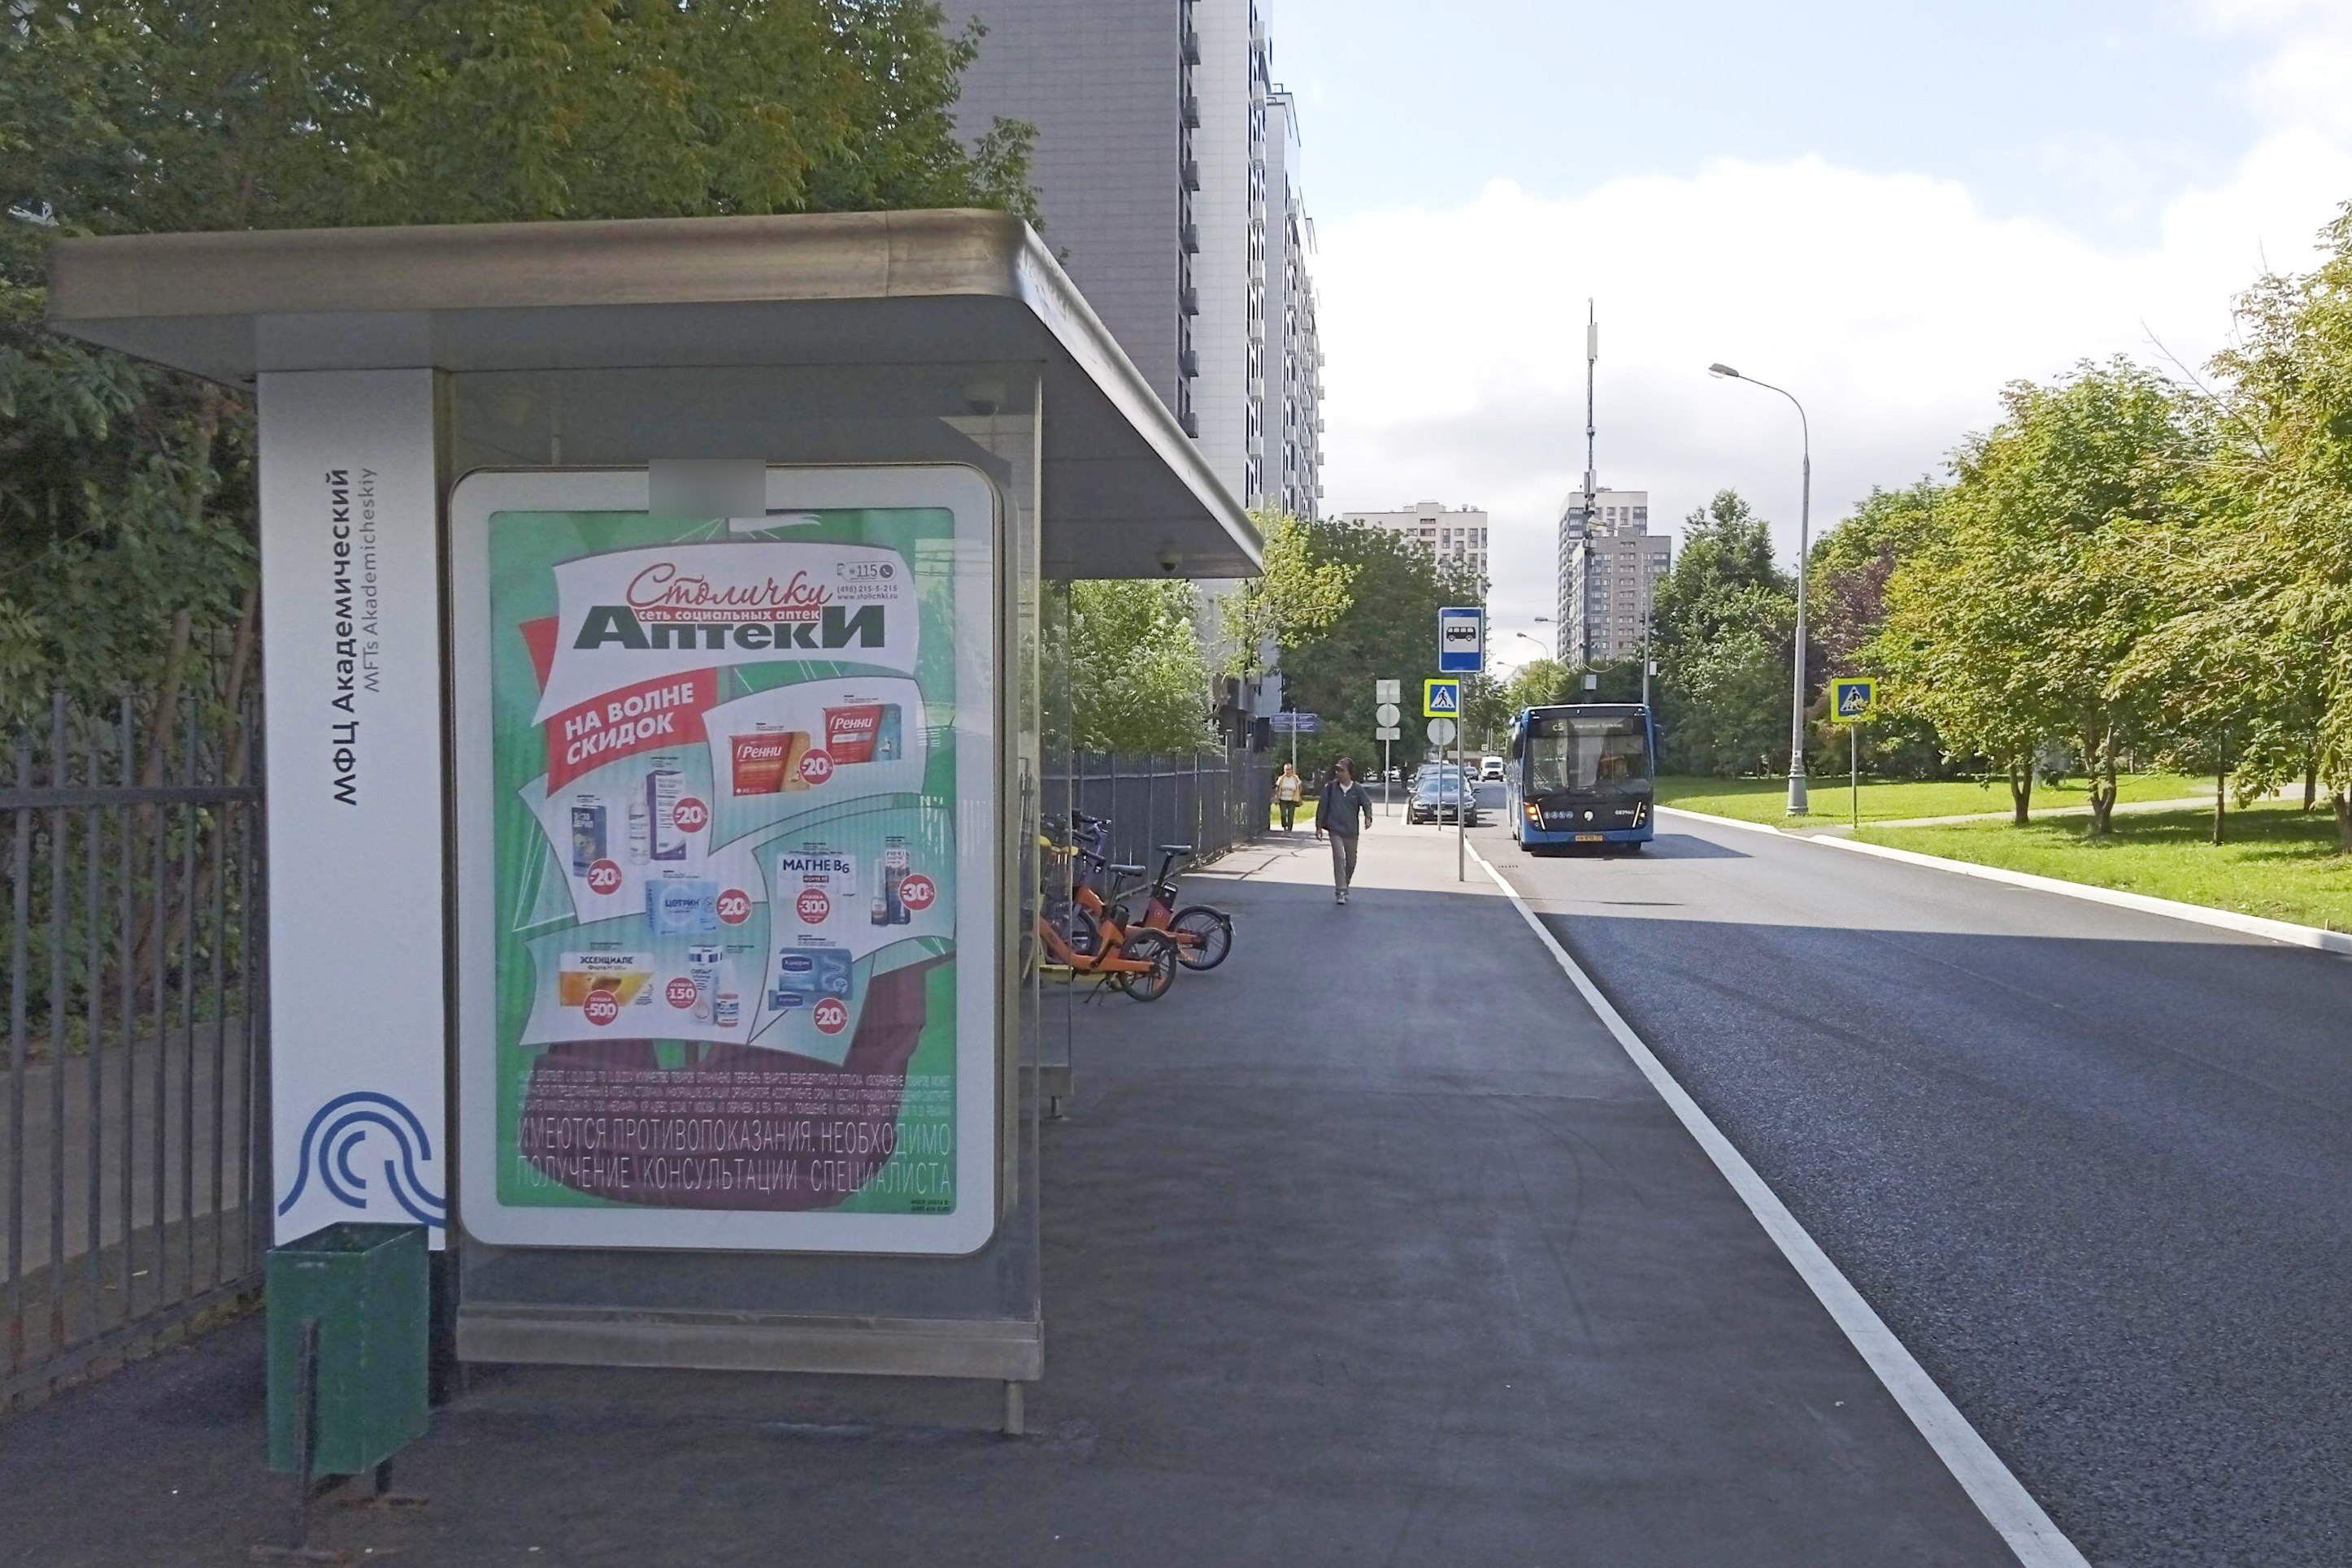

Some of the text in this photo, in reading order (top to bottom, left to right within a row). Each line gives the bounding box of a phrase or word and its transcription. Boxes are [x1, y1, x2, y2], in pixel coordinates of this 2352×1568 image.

[360, 467, 380, 693] MFTs Akademicheskiy
[626, 562, 833, 607] Столички
[639, 609, 821, 622] сеть социальных аптек
[326, 468, 359, 806] МФЦ Академический
[565, 682, 694, 741] НА ВОЛНЕ
[834, 717, 874, 730] Ренни
[567, 711, 675, 765] СКИДОК
[743, 745, 783, 759] Ренни
[783, 859, 831, 871] МАГНЕ
[585, 1002, 616, 1016] -500
[517, 1118, 951, 1160] ИМЕЮТСЯ ПРОТИВОПОКАЗАНИЯ. НЕОБХОДИМО
[517, 1155, 952, 1195] ПОЛУЧЕНИЕ КОНСУЛЬТАЦИИ СПЕЦИАЛИСТА
